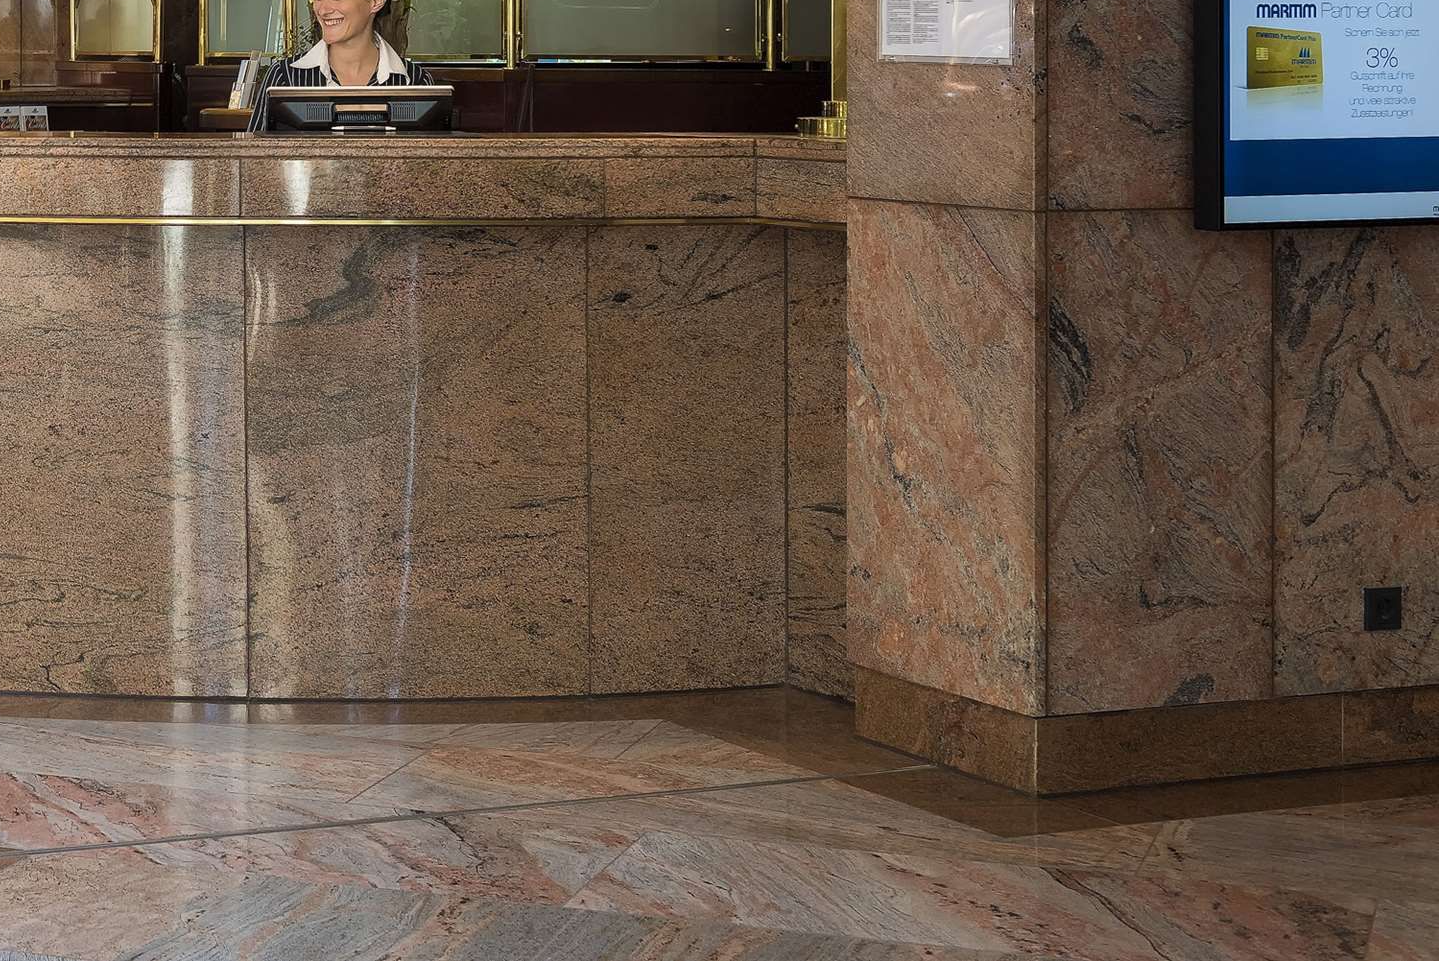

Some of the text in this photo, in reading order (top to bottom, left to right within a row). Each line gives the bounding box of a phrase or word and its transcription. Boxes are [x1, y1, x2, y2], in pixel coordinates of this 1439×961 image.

[1320, 1, 1372, 19] Partner
[1375, 1, 1413, 19] Card
[1366, 47, 1399, 68] 3%
